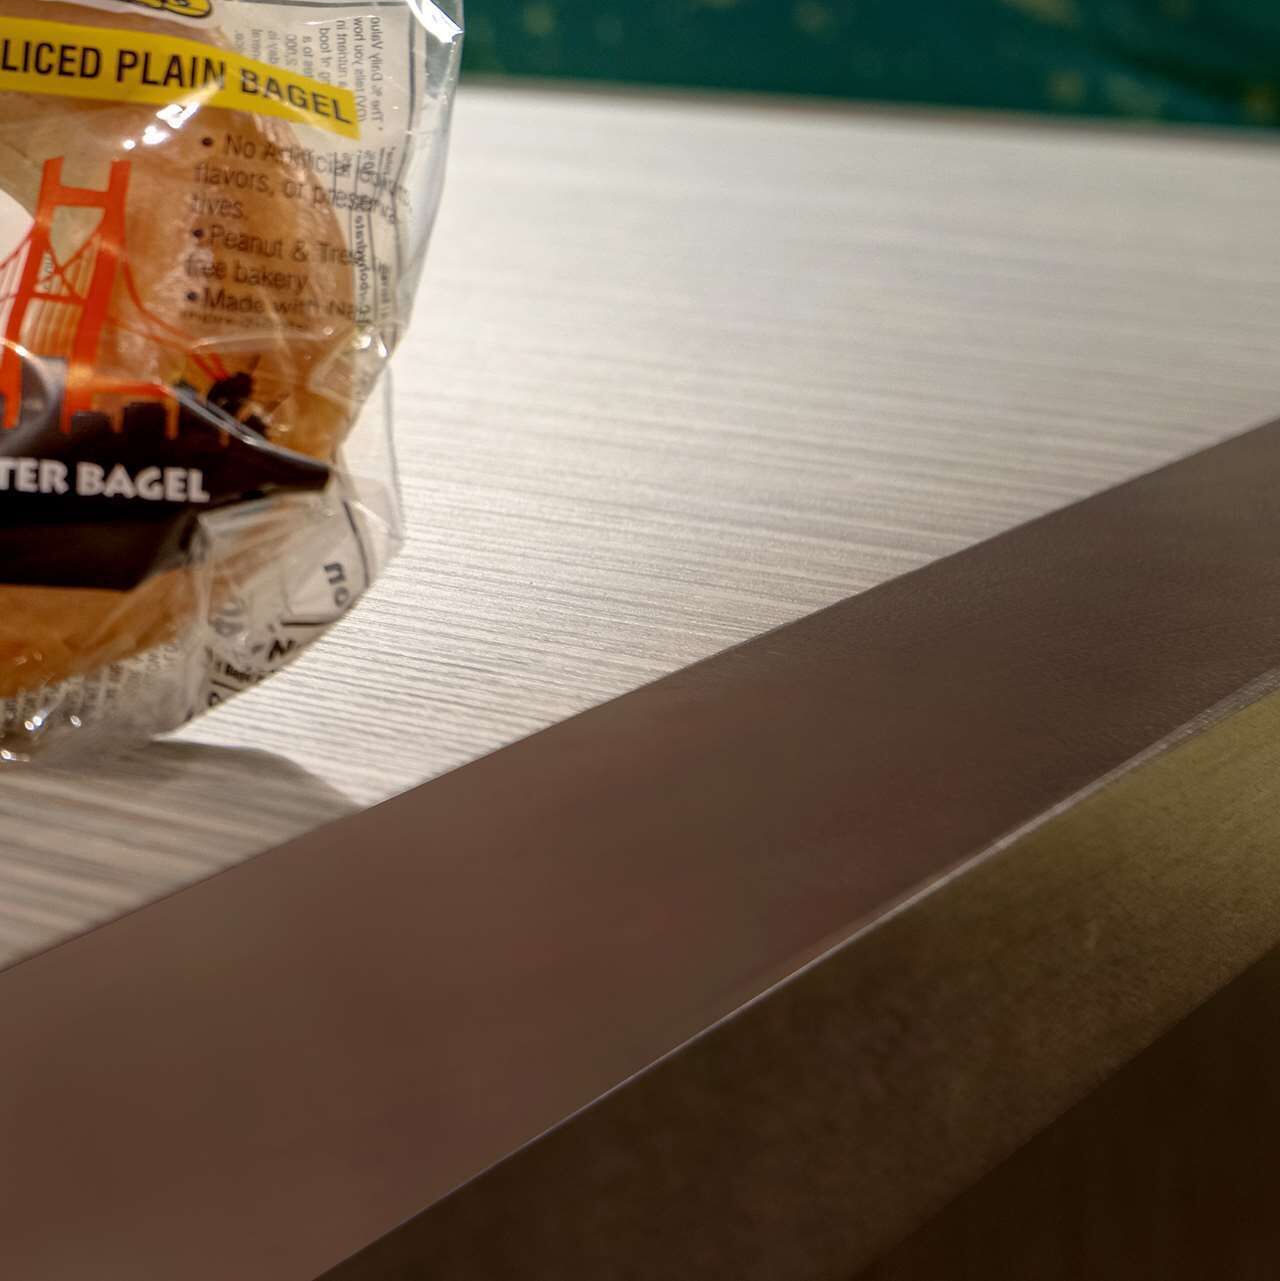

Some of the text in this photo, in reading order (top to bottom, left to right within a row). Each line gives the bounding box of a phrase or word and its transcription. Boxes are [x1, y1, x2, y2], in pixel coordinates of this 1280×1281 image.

[116, 48, 227, 92] PLAIN
[240, 68, 354, 124] BAGEL
[224, 135, 257, 160] No
[195, 163, 304, 199] flavors, or
[209, 224, 283, 260] Peanut
[292, 241, 307, 263] &
[233, 262, 309, 295] bakery
[203, 287, 264, 314] Made
[75, 460, 211, 504] BAGEL
